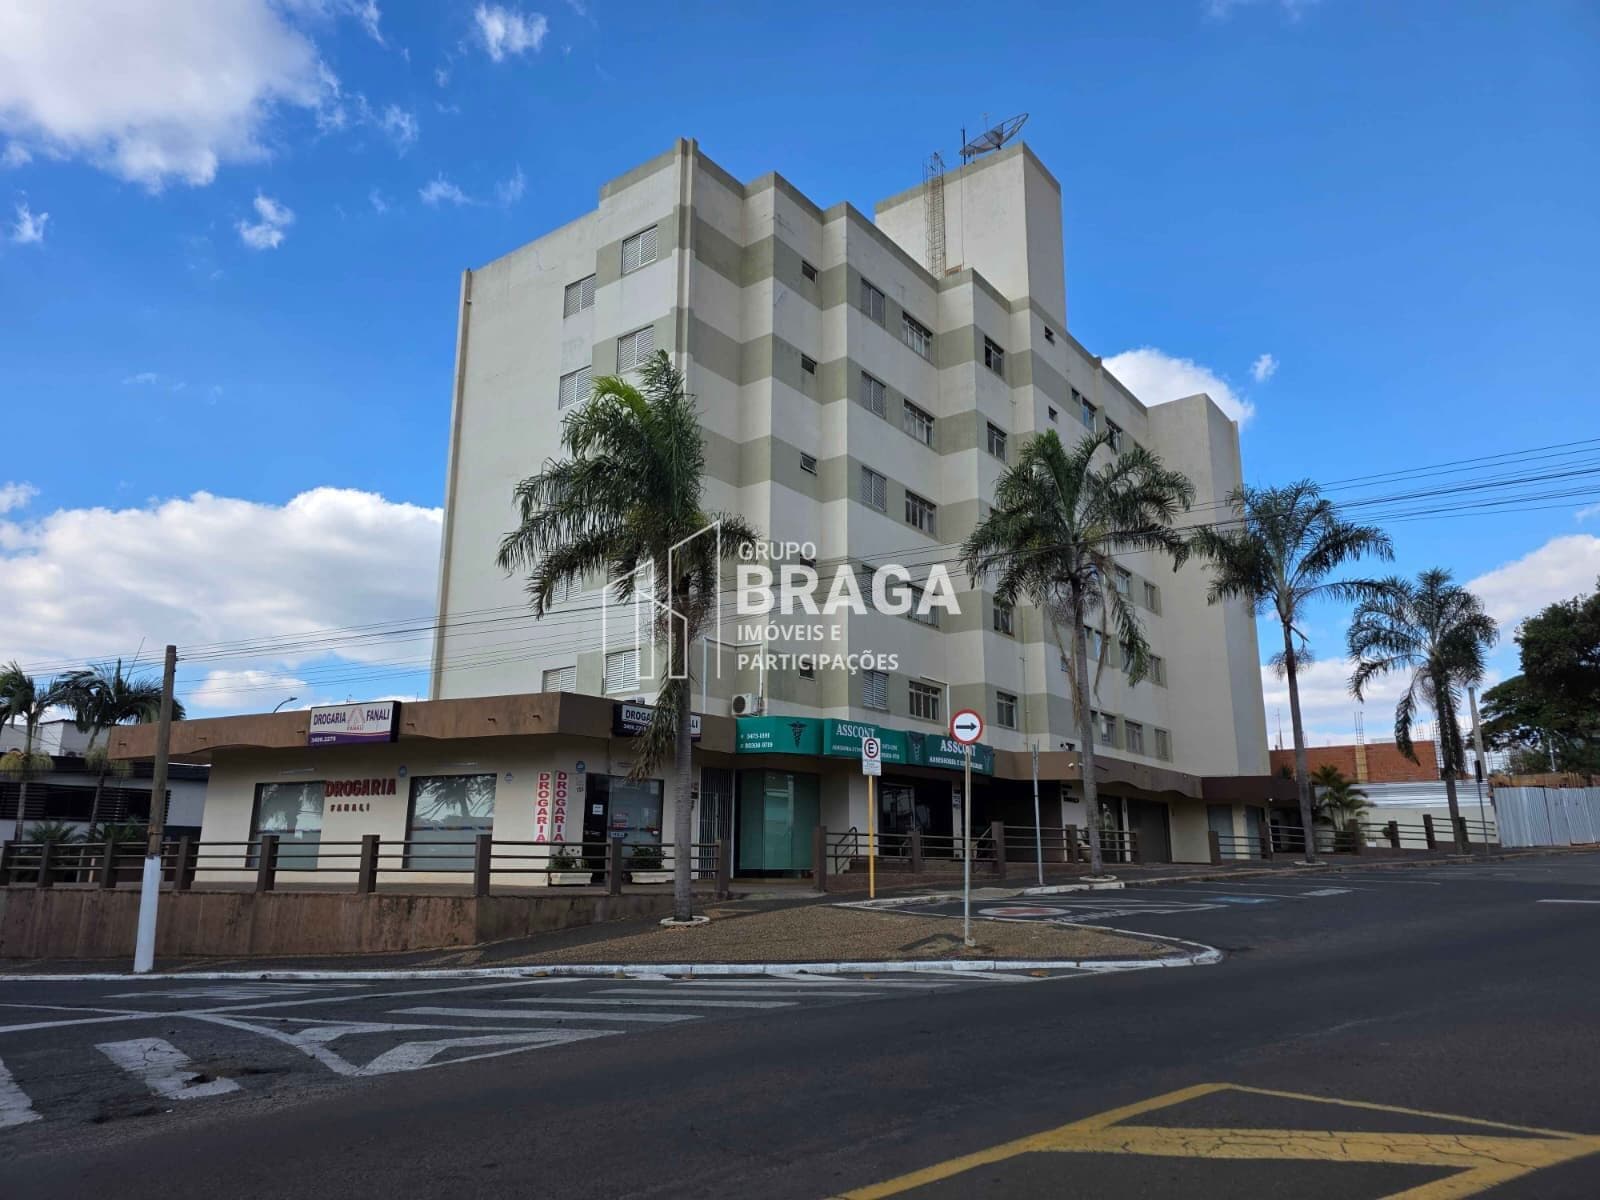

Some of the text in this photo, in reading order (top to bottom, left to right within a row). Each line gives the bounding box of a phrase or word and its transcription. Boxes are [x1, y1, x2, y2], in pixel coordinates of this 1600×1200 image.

[313, 708, 390, 726] DROGARIA FANALI
[868, 742, 875, 754] E
[325, 779, 396, 797] DROGARIA
[536, 773, 550, 841] DROGARIA
[554, 772, 567, 841] DROGARIA
